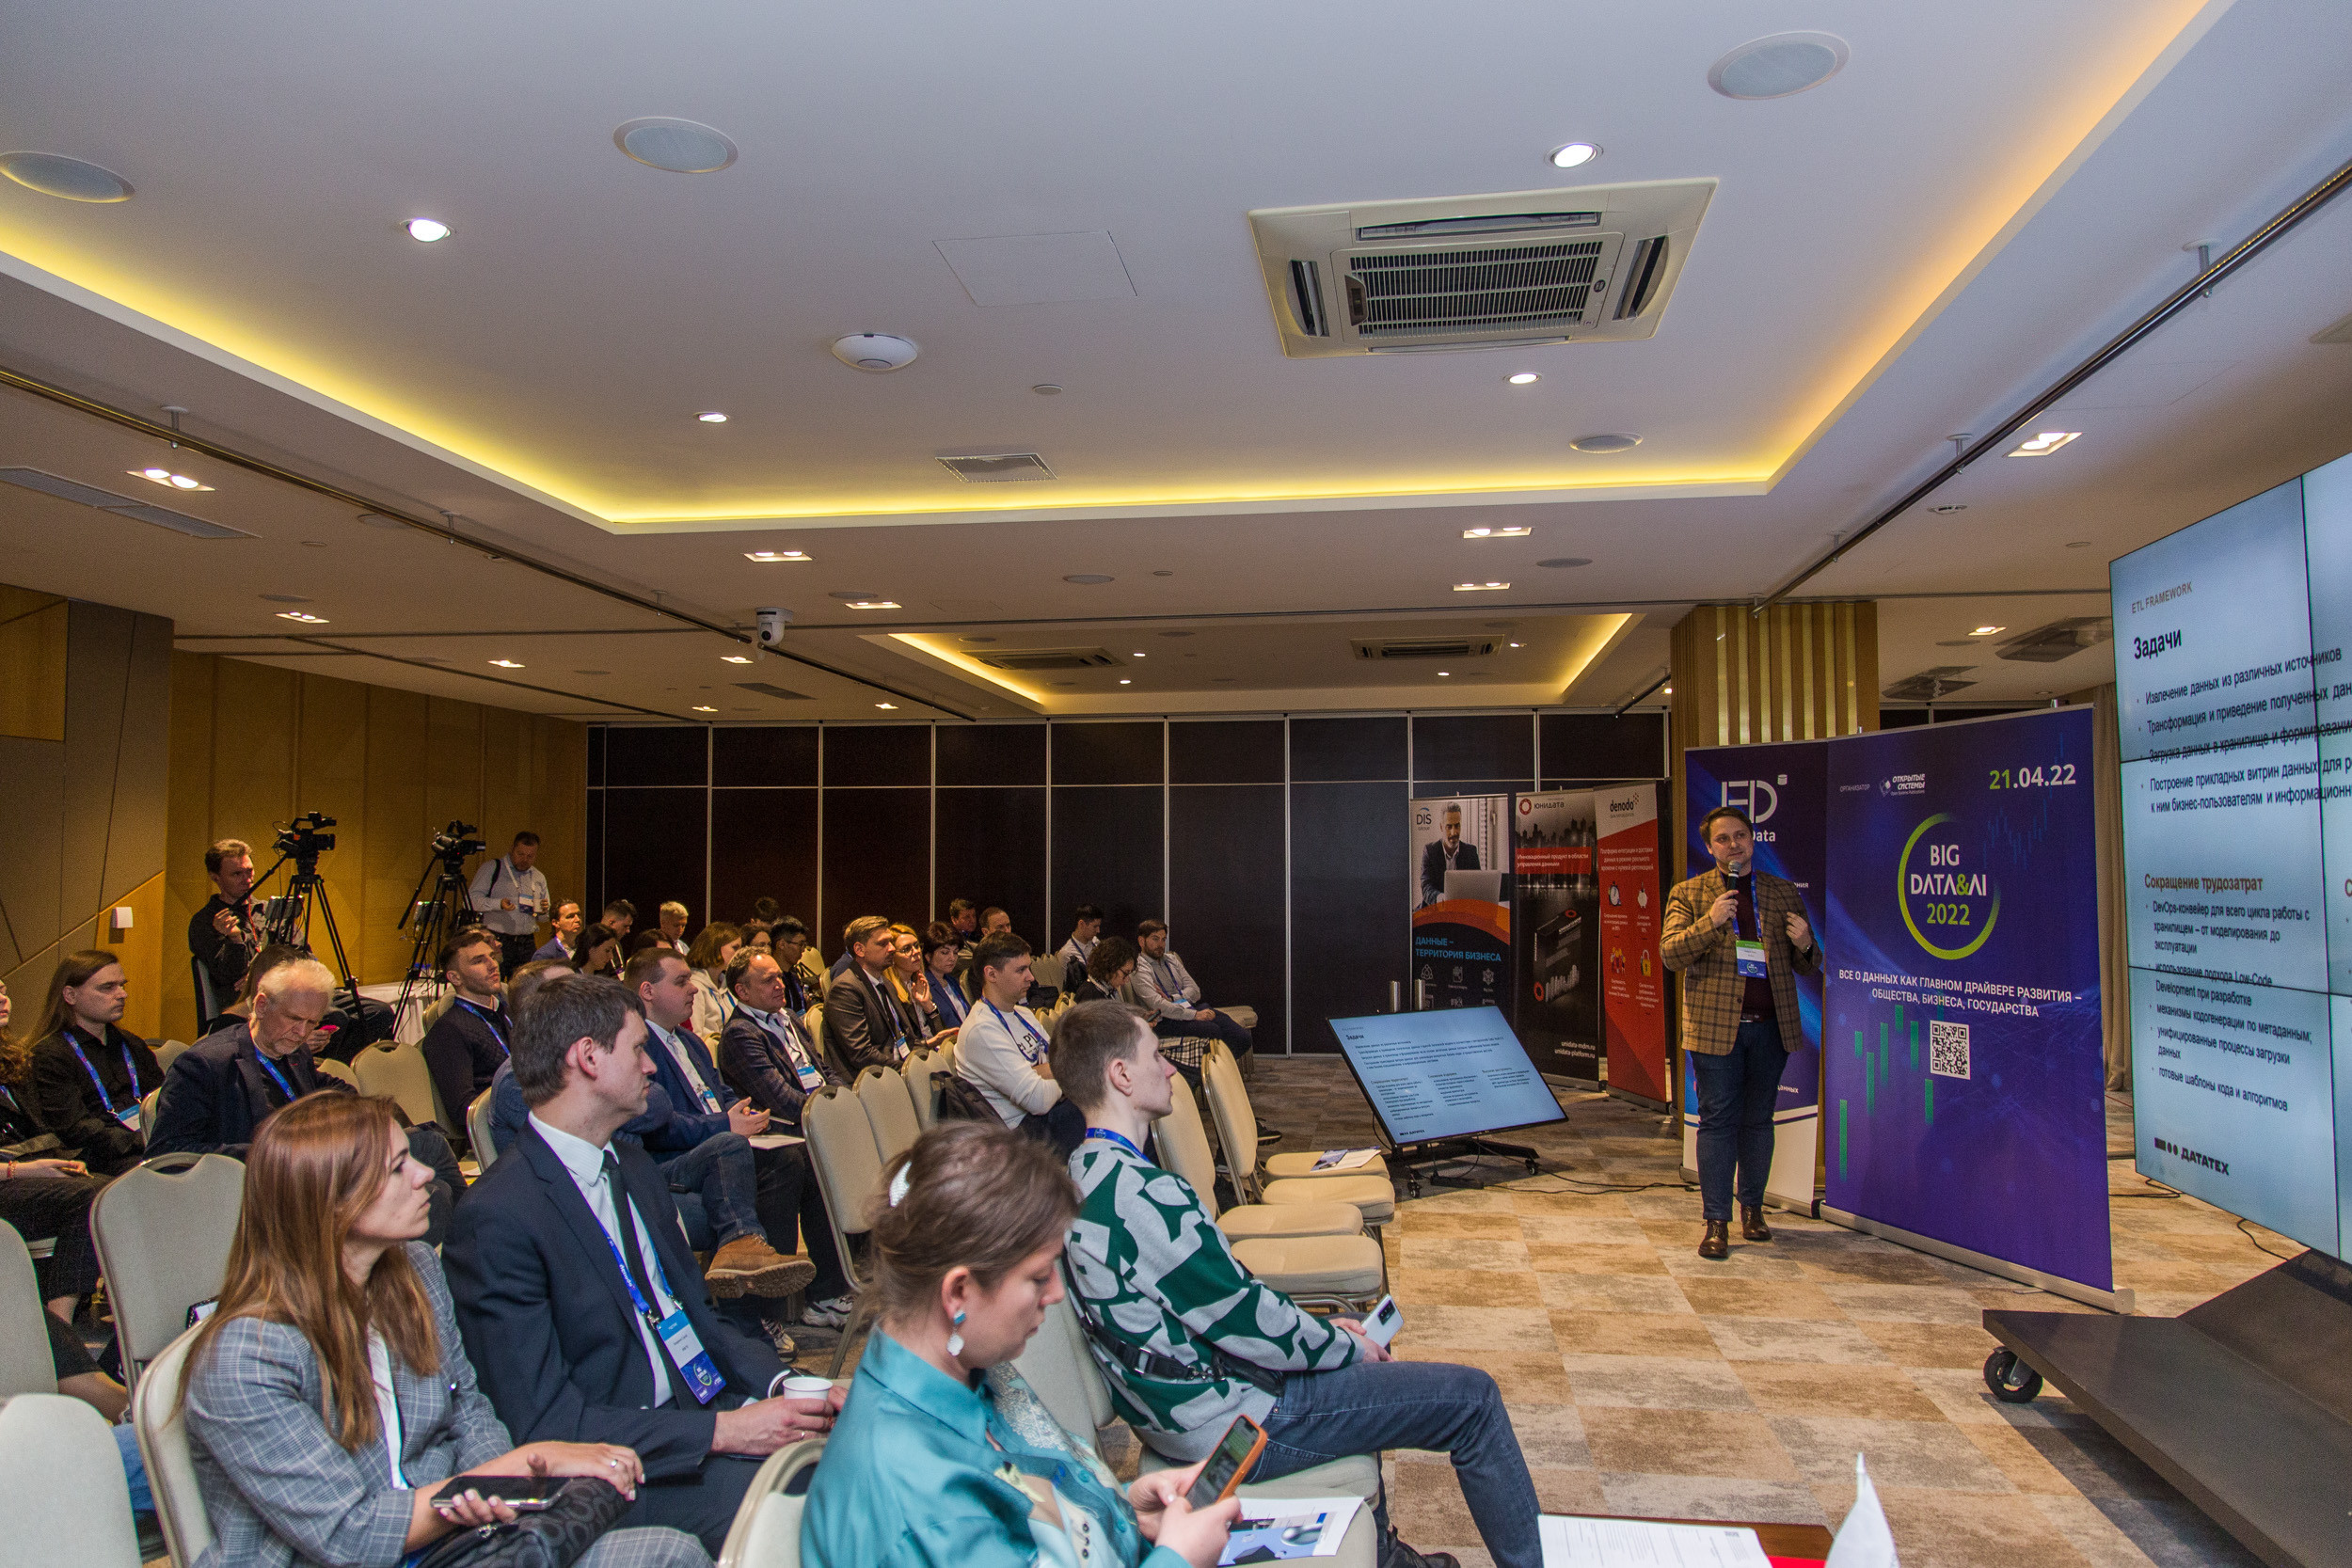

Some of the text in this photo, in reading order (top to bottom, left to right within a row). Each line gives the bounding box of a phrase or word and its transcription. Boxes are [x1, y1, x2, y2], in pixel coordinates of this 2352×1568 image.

[2131, 581, 2193, 613] ETL FRAMEWORK
[2134, 628, 2182, 659] Задачи
[2146, 647, 2342, 705] Извлечение данных из различных источников
[2147, 711, 2206, 736] Трансформация
[2209, 709, 2215, 721] и
[2217, 700, 2267, 721] приведение
[2270, 686, 2328, 712] полученных
[2149, 747, 2180, 765] Загрузка
[2182, 741, 2210, 760] данных
[2213, 741, 2218, 752] в
[2220, 733, 2268, 755] хранилище
[2272, 732, 2278, 744] и
[1892, 773, 1926, 783] ОТКРЫТЫЕ
[1897, 782, 1926, 790] СИСТЕМЫ
[1989, 764, 2076, 790] 21.04.22
[2150, 776, 2193, 793] Построение
[2196, 769, 2244, 789] прикладных
[2248, 766, 2279, 783] витрин
[2281, 761, 2317, 779] данных
[2322, 758, 2342, 775] для
[1839, 784, 1870, 792] ОРГАНИЗАТОР
[1610, 799, 1633, 812] denodo
[2151, 802, 2155, 813] к
[2156, 800, 2170, 813] ним
[2171, 792, 2263, 812] бизнес-пользователям
[2266, 792, 2272, 803] и
[1416, 814, 1432, 825] DIS
[1931, 845, 1960, 866] BIG
[1910, 873, 1987, 895] DATA&AI
[2144, 873, 2263, 895] Сокращение трудозатрат
[1927, 903, 1970, 926] 2022
[2153, 900, 2310, 922] DevOps-конвейер для всего цикла работы с
[1415, 937, 1448, 946] ДАННЫЕ
[2153, 921, 2193, 936] хранилищем
[2201, 926, 2209, 935] от
[2210, 927, 2267, 942] моделирования
[2269, 930, 2280, 943] до
[1415, 948, 1502, 961] ТЕРРИТОРИЯ БИЗНЕСА
[2154, 941, 2198, 955] эксплуатации
[1838, 969, 1853, 980] ВСЕ
[1855, 971, 1861, 981] О
[1863, 971, 1899, 985] ДАННЫХ
[1900, 975, 1917, 987] КАК
[1919, 976, 1963, 991] ГЛАВНОМ
[1964, 981, 2014, 998] ДРАЙВЕРЕ
[2017, 986, 2072, 1003] РАЗВИТИЯ
[2234, 971, 2273, 987] Low-Code
[1872, 988, 2039, 1018] ОБЩЕСТВА, БИЗНЕСА, ГОСУДАРСТВА
[2155, 979, 2252, 1006] Development при разработке
[2156, 1004, 2312, 1044] механизмы кодогенерации по метаданным;
[2157, 1026, 2291, 1065] унифицированные процессы загрузки
[2158, 1044, 2181, 1059] данных
[2158, 1067, 2288, 1112] готовые шаблоны кода и алгоритмов
[2181, 1147, 2229, 1176] ДАТАТЕХ
